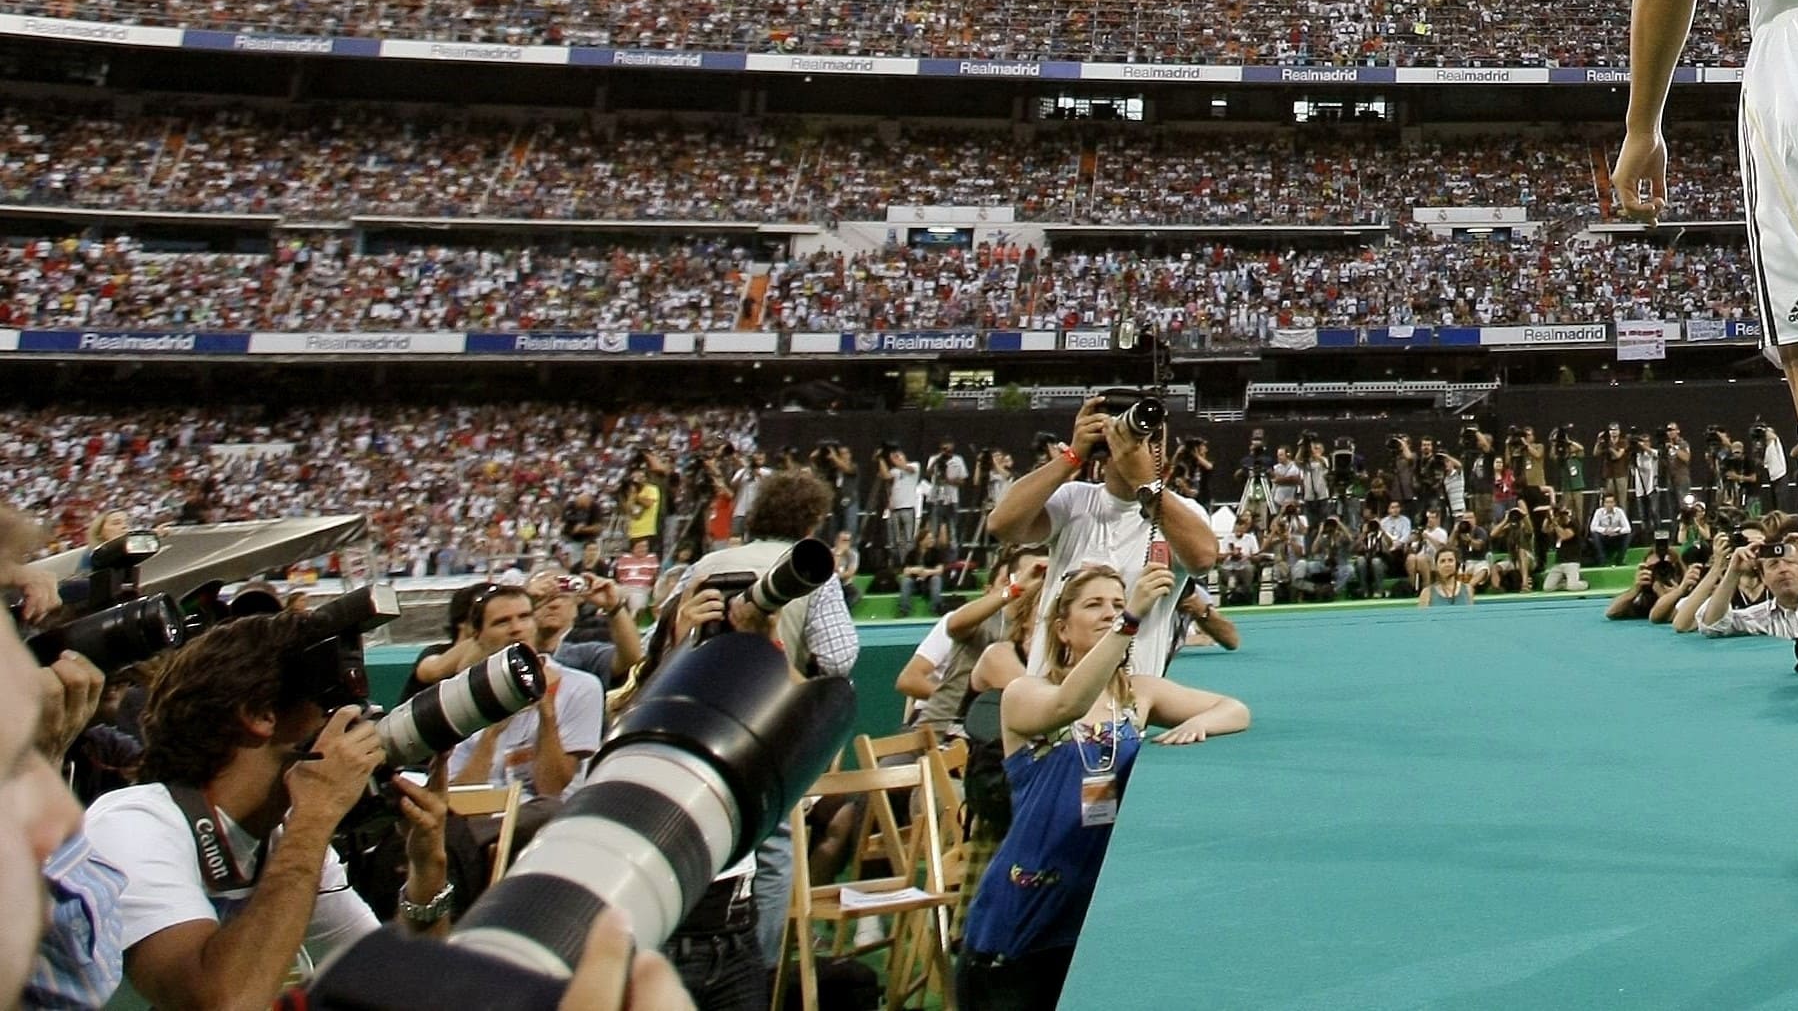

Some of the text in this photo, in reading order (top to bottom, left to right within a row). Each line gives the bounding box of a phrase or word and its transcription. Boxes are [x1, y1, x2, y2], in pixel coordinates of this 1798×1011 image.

[613, 51, 701, 67] Realmadrid
[791, 57, 873, 72] Realmadrid
[960, 61, 1040, 76] Realmadrid
[1123, 66, 1200, 79] Realmadrid
[1282, 68, 1357, 81] Realmadrid
[1436, 70, 1509, 82] Realmadrid
[79, 333, 195, 350] Realmadrid
[1524, 327, 1604, 341] Realmadrid
[883, 335, 976, 350] Realmadrid
[196, 818, 229, 881] Canon
